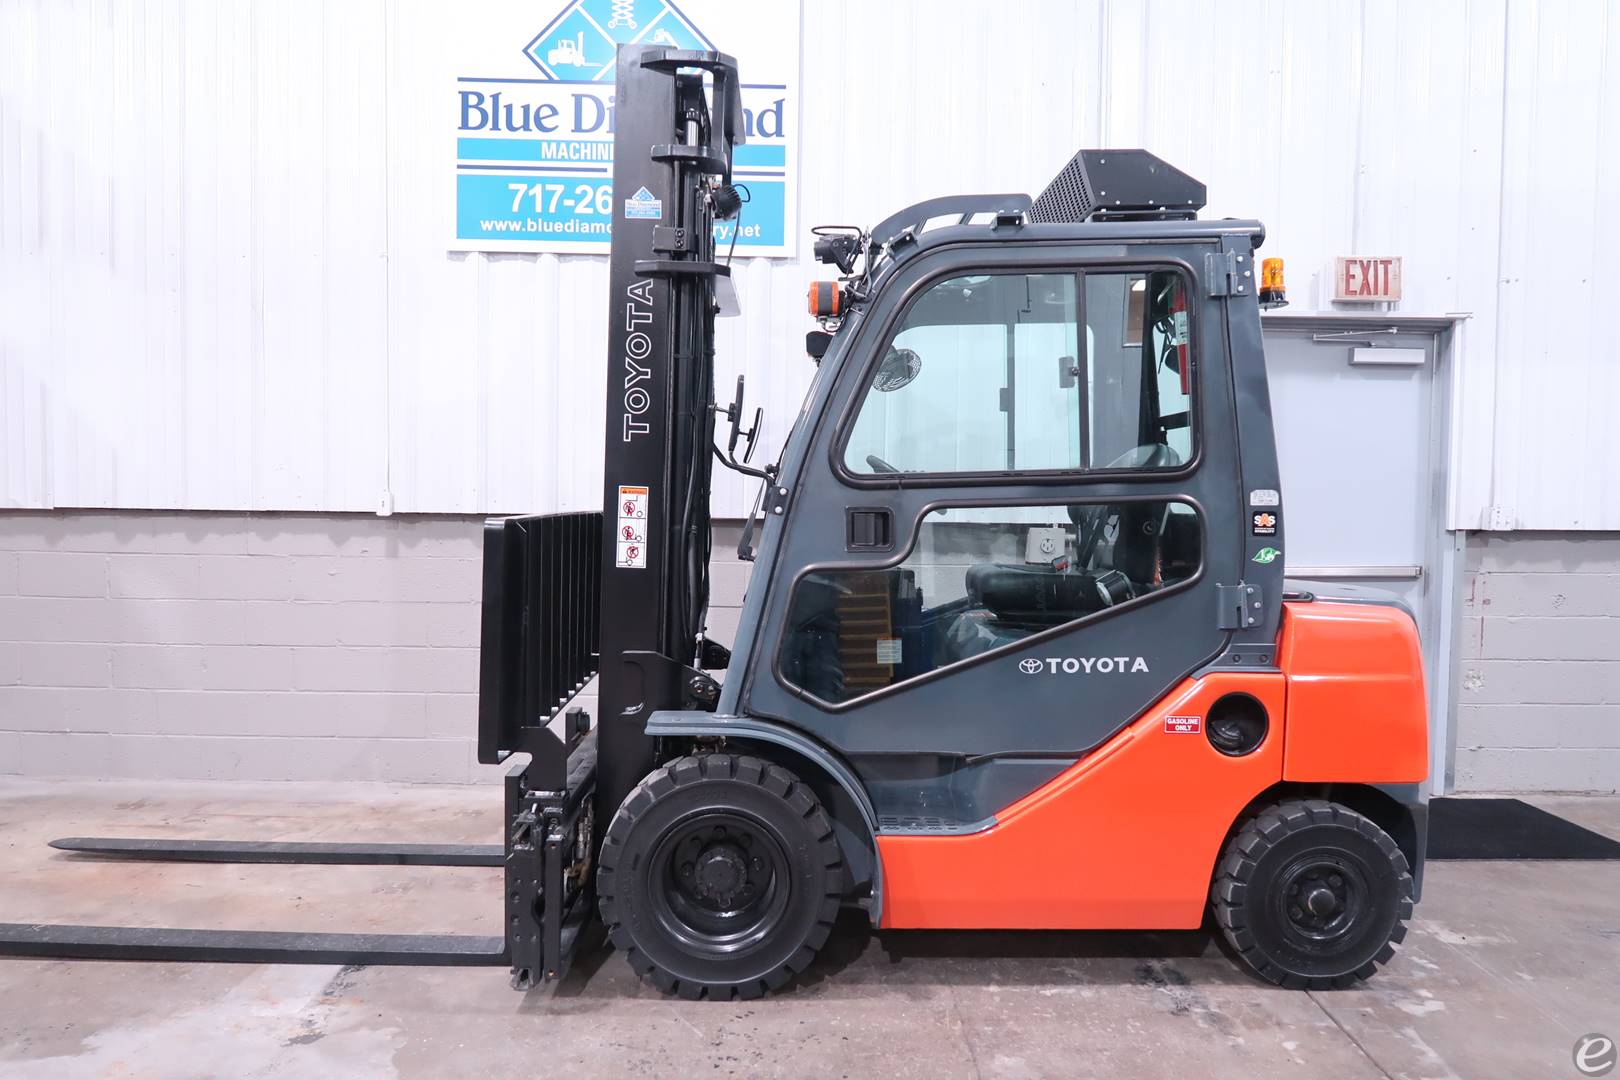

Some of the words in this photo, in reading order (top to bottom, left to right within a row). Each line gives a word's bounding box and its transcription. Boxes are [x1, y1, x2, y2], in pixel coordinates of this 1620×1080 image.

[457, 90, 560, 133] Blue
[541, 141, 614, 161] MACHIN
[508, 183, 613, 216] 717-26
[1344, 259, 1393, 296] EXIT
[623, 278, 654, 442] TOYOTA
[1254, 512, 1276, 527] SAS
[1046, 656, 1150, 674] TOYOTA
